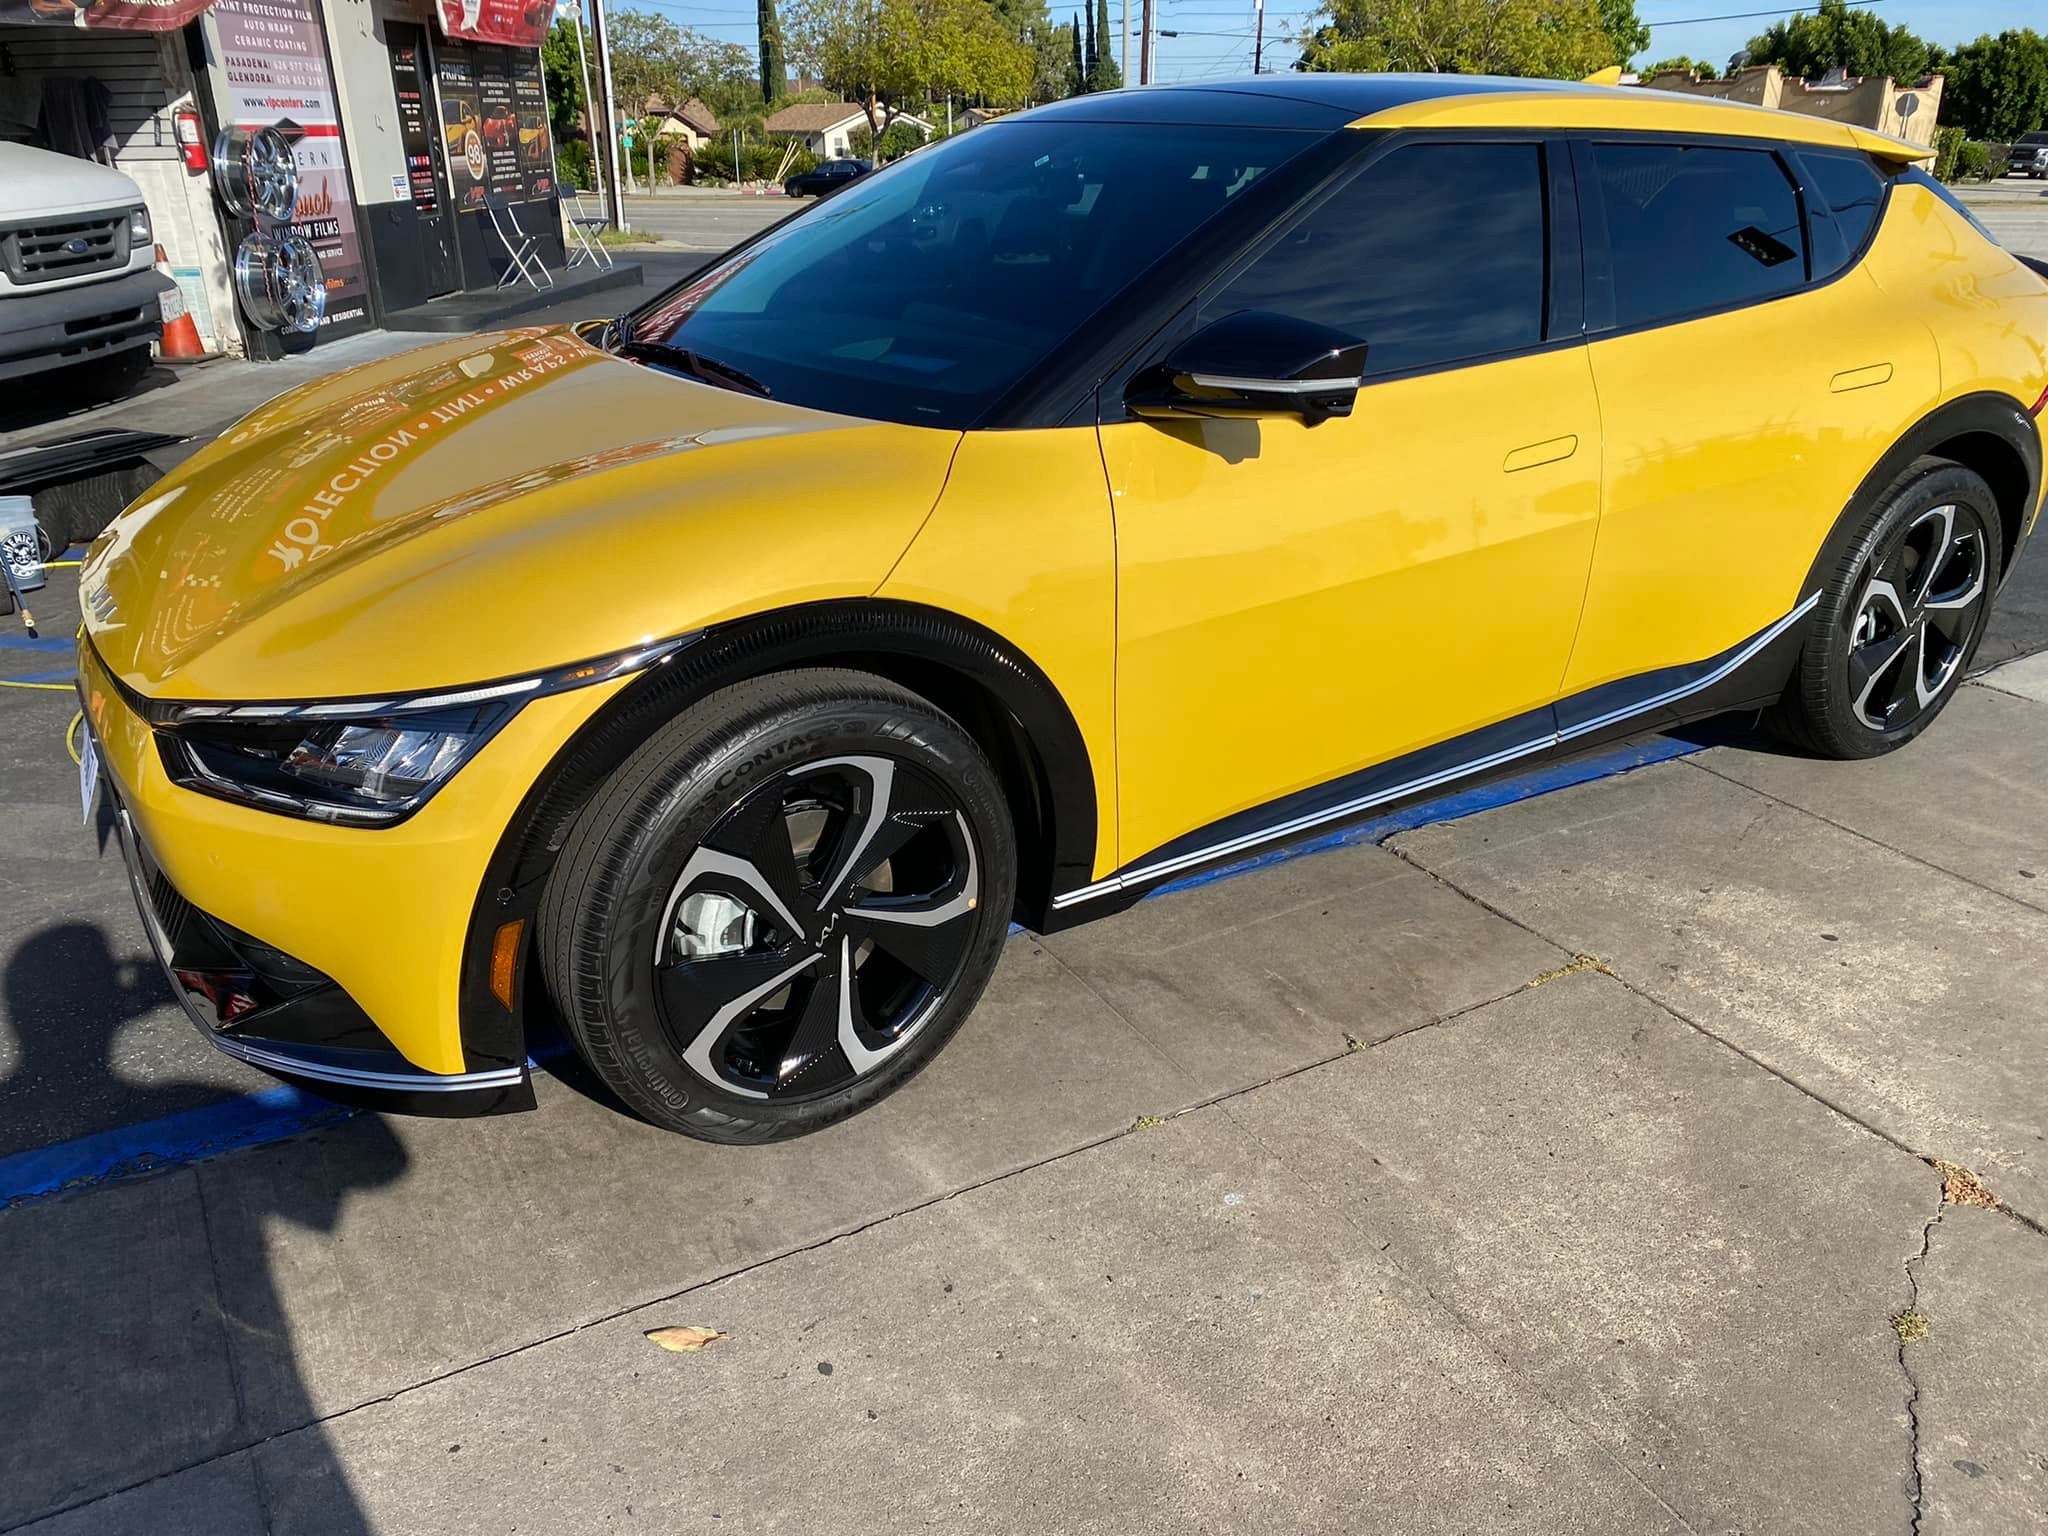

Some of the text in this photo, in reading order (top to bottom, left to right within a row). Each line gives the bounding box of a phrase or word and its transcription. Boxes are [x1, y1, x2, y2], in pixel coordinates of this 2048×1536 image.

[243, 3, 294, 19] PROTECTION
[295, 9, 313, 22] FILM
[243, 19, 294, 35] AUTO WRAPS
[234, 35, 308, 52] CERAMIC COATING
[225, 55, 272, 70] PASADENA:
[227, 71, 274, 83] GLENDORA:
[272, 220, 339, 241] WINDOW FILMS
[332, 307, 364, 323] RESIDENTIAL
